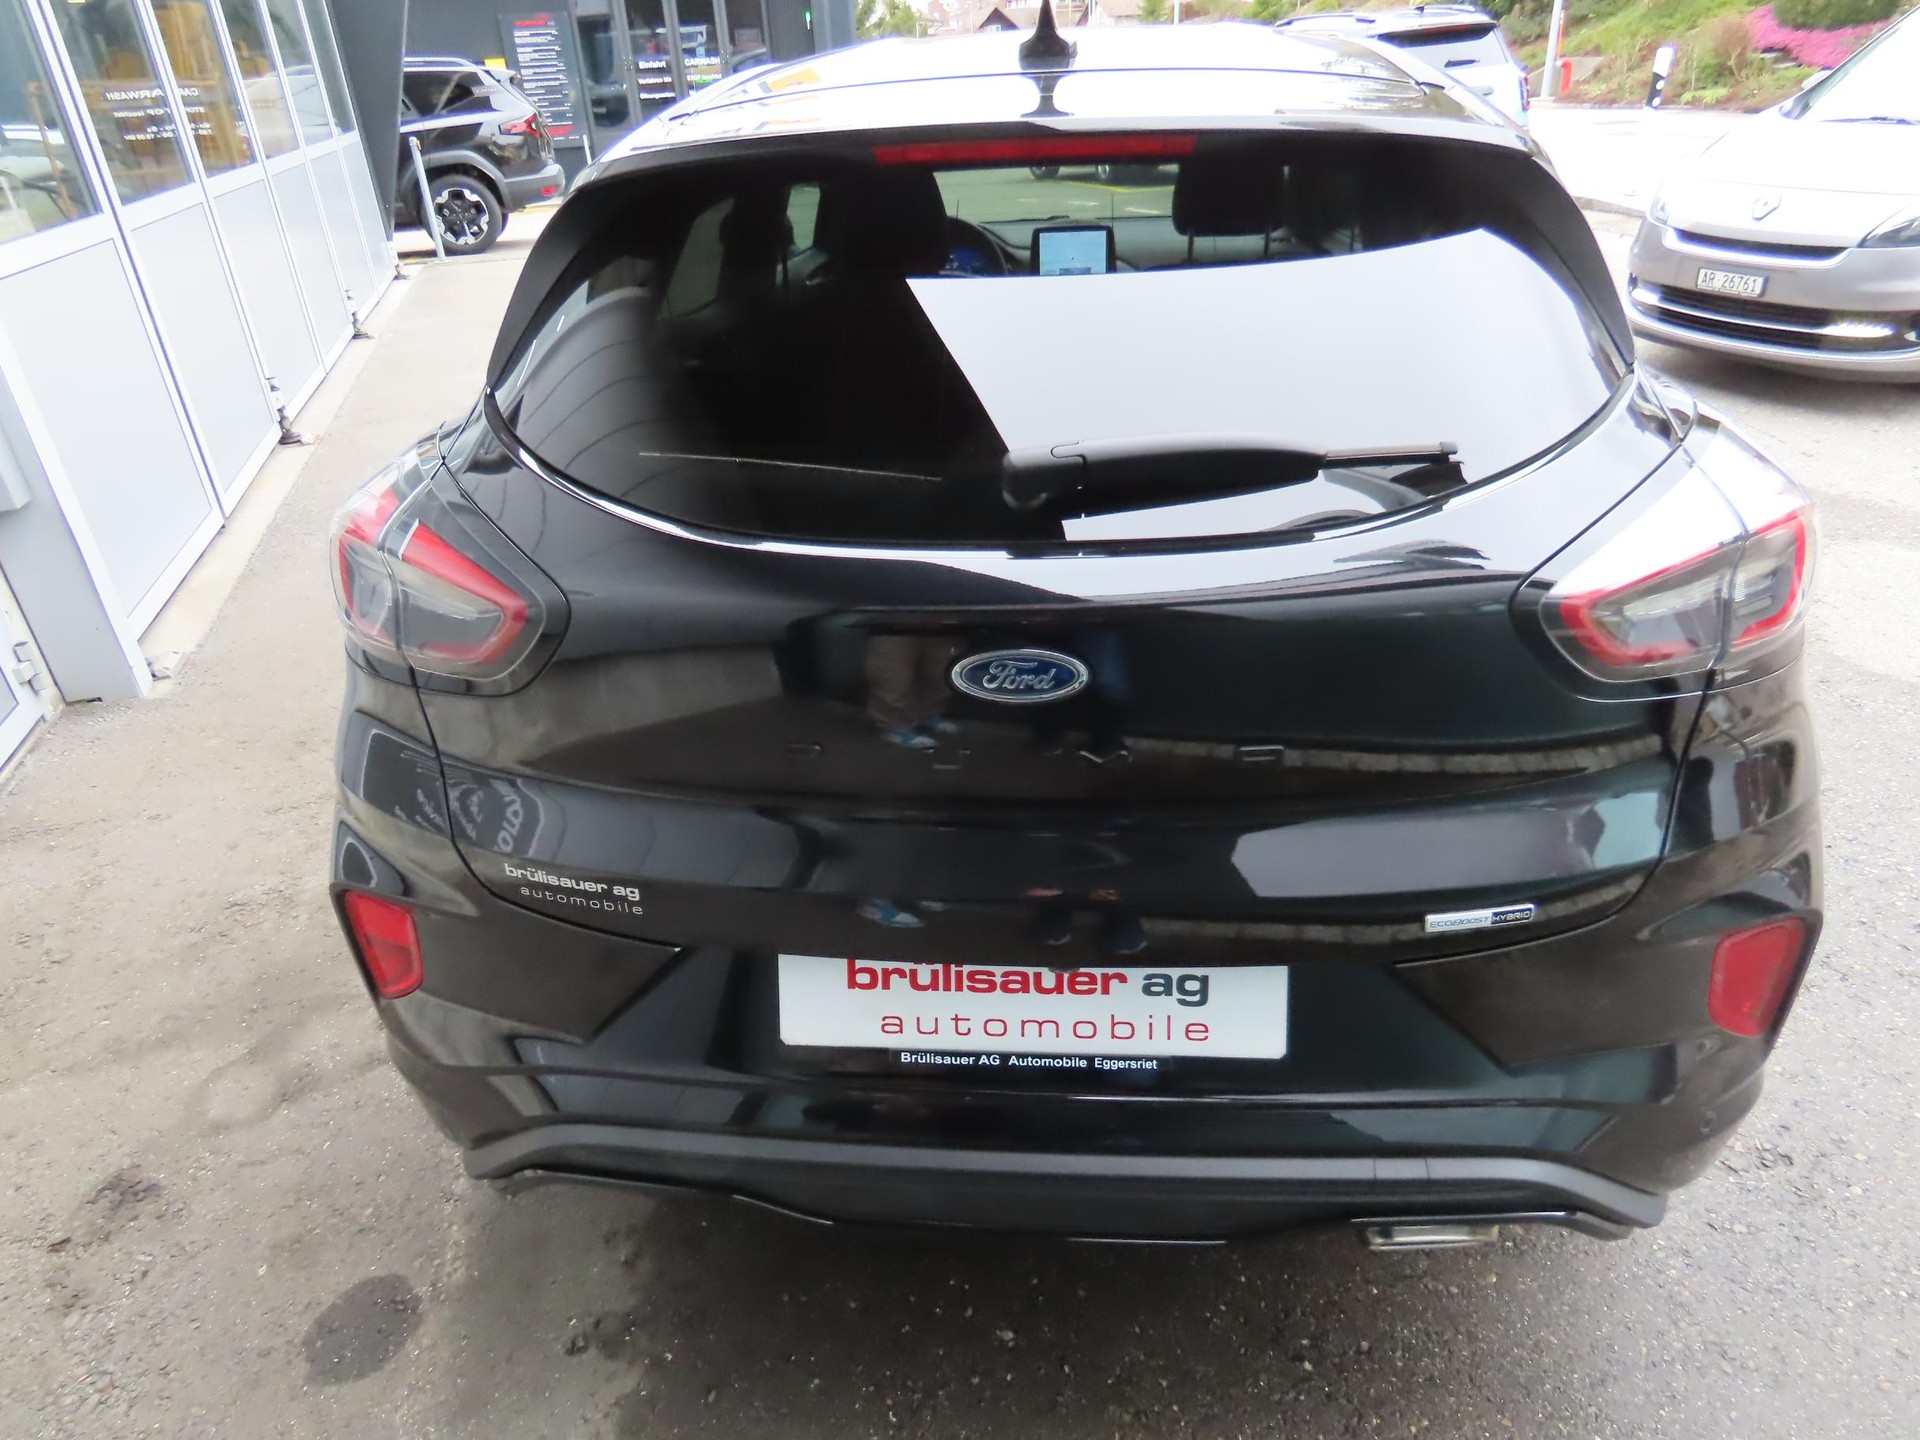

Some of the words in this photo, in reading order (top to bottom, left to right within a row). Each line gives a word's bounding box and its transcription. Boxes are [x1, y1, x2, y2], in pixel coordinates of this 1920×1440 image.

[684, 56, 721, 67] CARWASH
[1701, 272, 1716, 287] AR
[1721, 274, 1757, 292] 26761
[981, 660, 1055, 692] Ford
[504, 863, 608, 893] brülisauer
[612, 884, 640, 901] ag
[520, 885, 643, 916] automobile
[1430, 916, 1490, 928] ECOBOOST
[1492, 910, 1531, 922] HYBRID
[846, 958, 1127, 996] brülisauer
[1141, 971, 1210, 1007] ag
[880, 1013, 1210, 1042] automobile
[900, 1051, 976, 1066] Brülisauer
[978, 1053, 1001, 1066] AG
[1008, 1055, 1088, 1069] Automobile
[1094, 1056, 1158, 1071] Eggersriet
